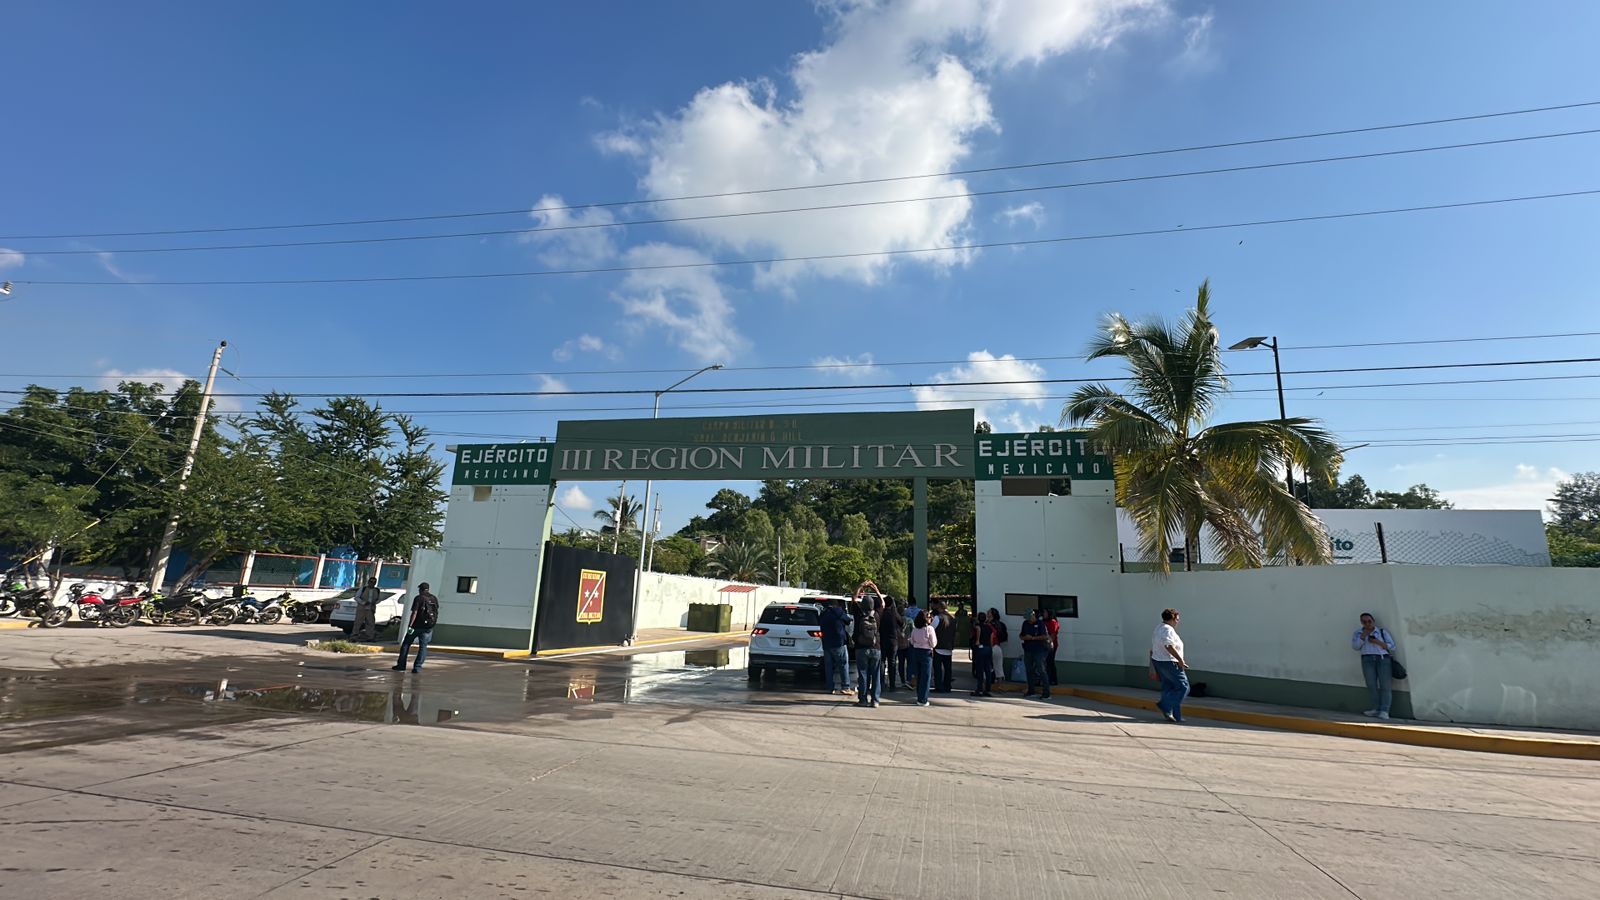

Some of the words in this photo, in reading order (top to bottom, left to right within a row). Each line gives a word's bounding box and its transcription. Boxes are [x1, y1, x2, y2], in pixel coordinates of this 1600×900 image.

[460, 444, 549, 464] EJÉRCITO
[978, 434, 1109, 457] EJÉRCITO
[560, 448, 592, 470] III
[602, 447, 745, 470] REGION
[760, 443, 966, 470] MILITAR
[463, 468, 541, 480] MEXICANO
[988, 463, 1101, 475] MEXICANO
